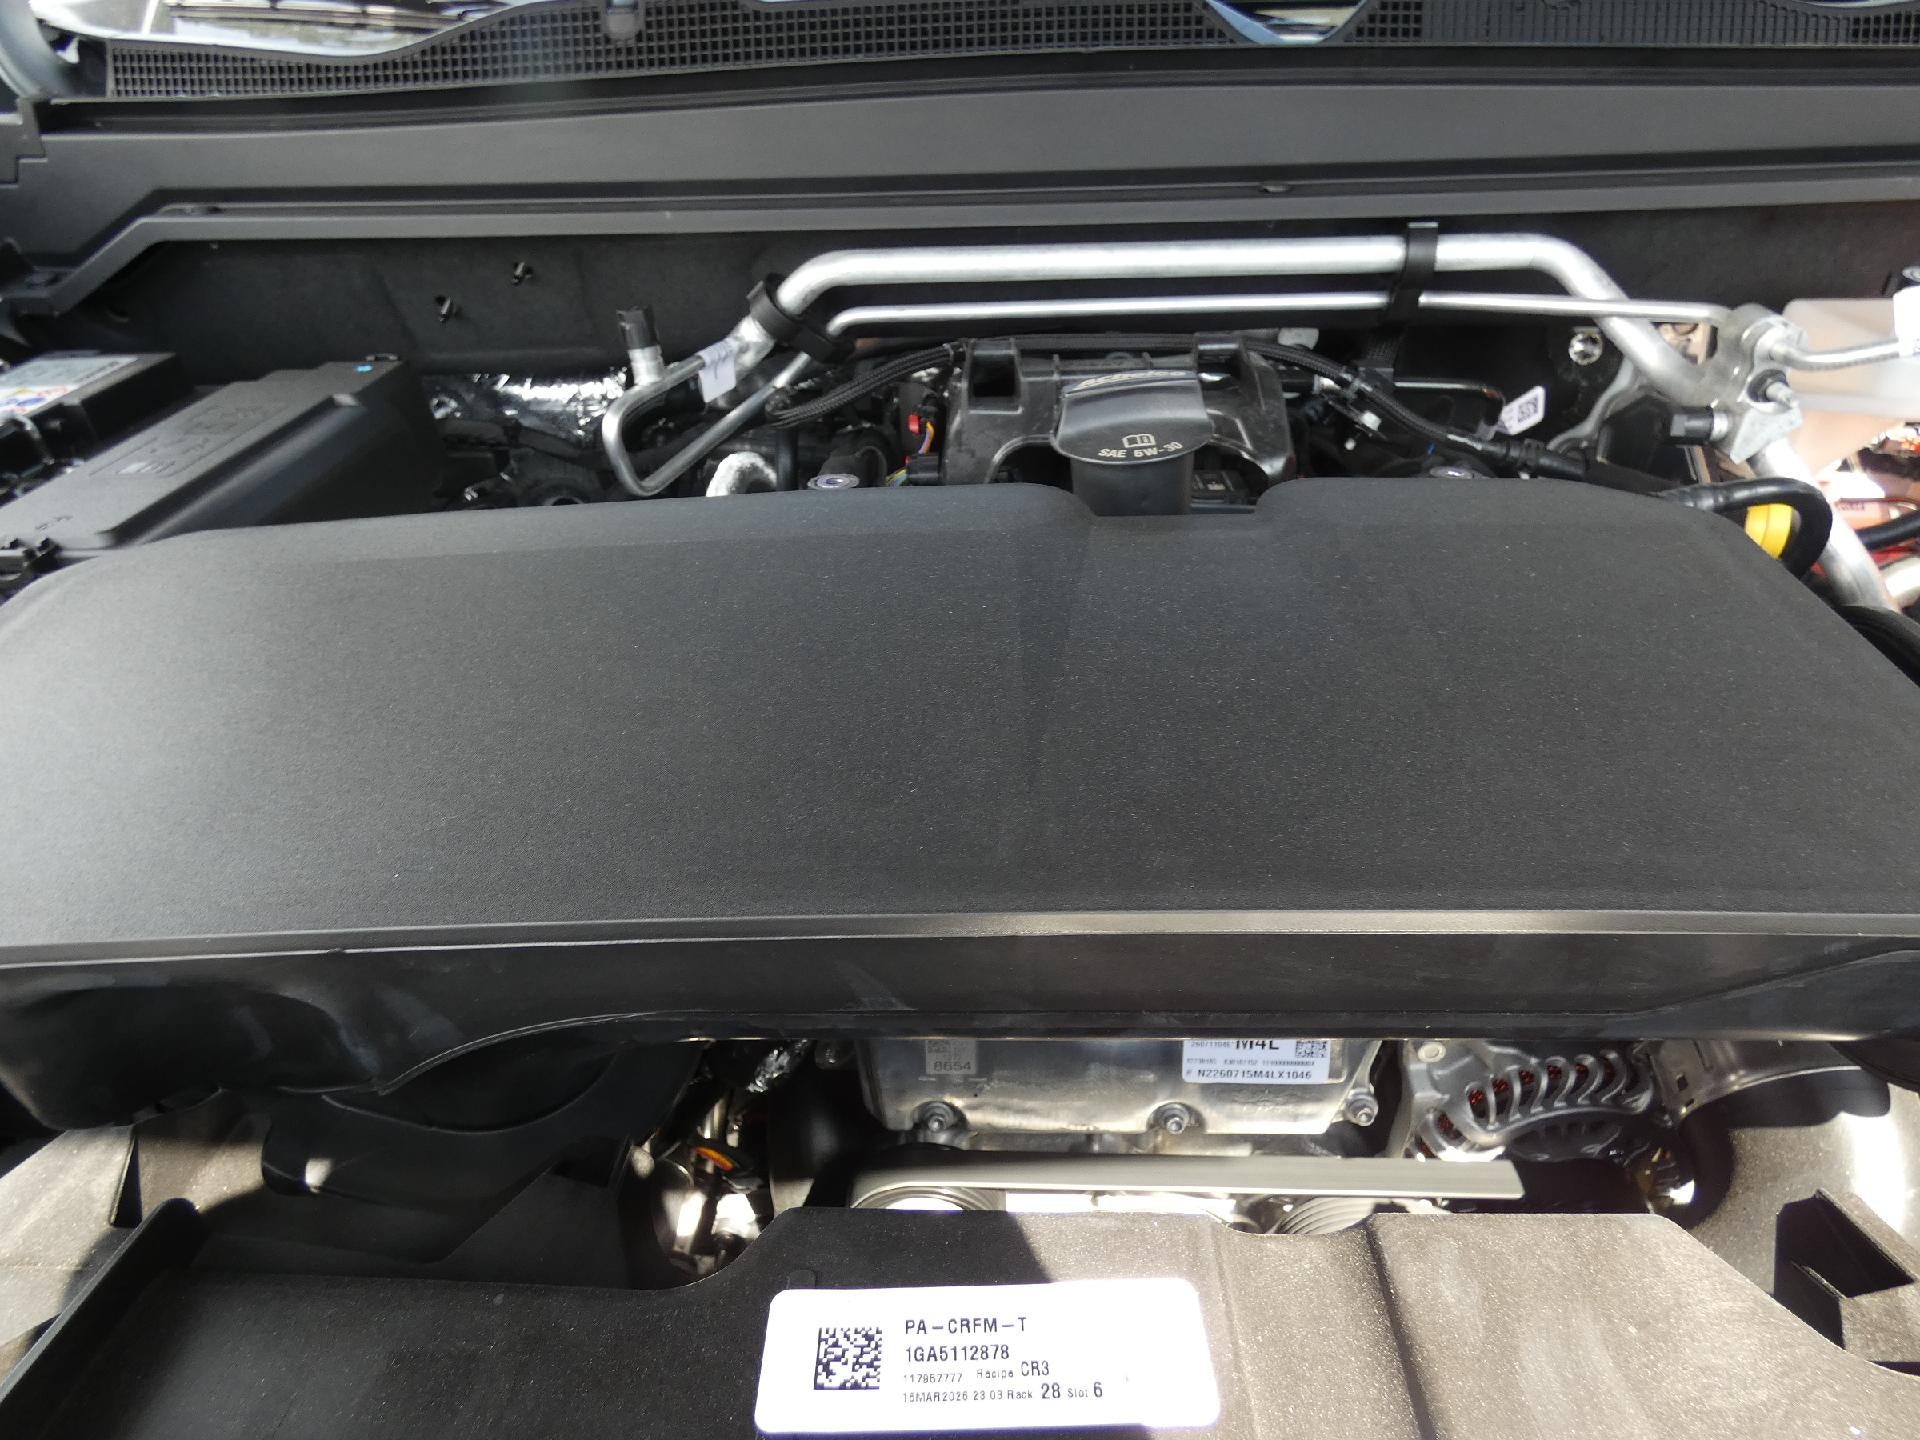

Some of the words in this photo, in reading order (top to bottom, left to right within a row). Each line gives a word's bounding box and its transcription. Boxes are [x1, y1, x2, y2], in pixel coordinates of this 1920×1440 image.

[1098, 448, 1127, 458] SAE
[905, 1344, 1010, 1362] 1GA5112878
[1021, 1360, 1050, 1377] CR3
[1007, 1389, 1033, 1399] Rack
[1041, 1382, 1061, 1399] 28
[1093, 1381, 1103, 1398] 6
